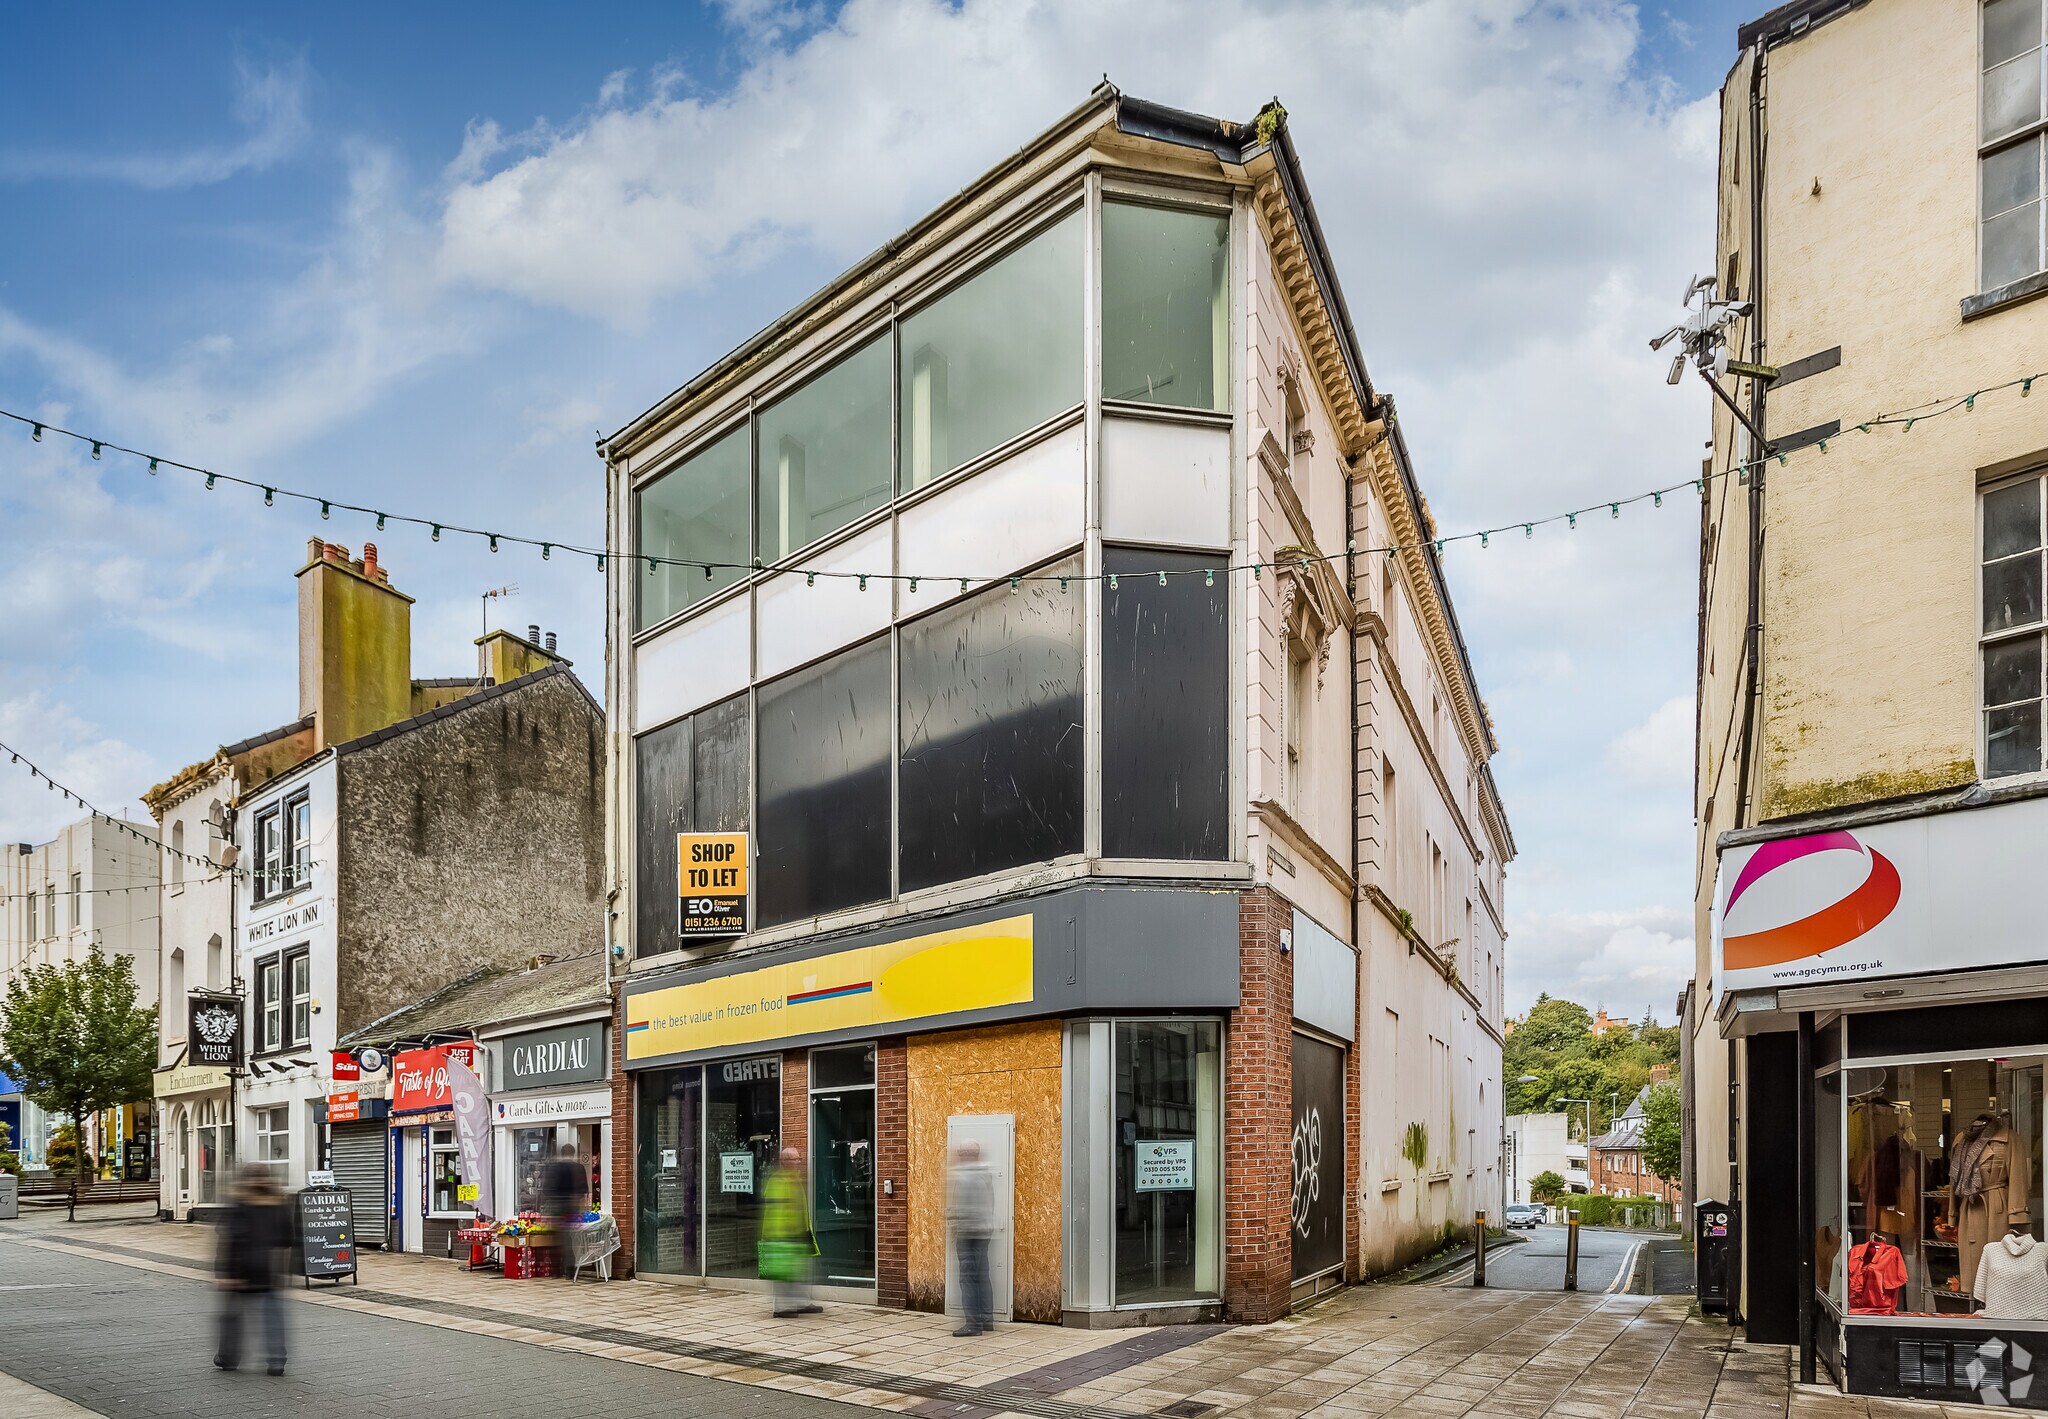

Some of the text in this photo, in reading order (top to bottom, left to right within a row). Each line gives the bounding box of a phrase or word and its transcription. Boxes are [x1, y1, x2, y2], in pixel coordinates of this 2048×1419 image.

[691, 843, 735, 863] SHOP
[688, 868, 738, 888] TO LET
[248, 904, 318, 943] WHITE LION INN
[685, 916, 742, 927] 0151 236 6700
[1772, 959, 1884, 979] www.agecymru.org.uk
[653, 995, 783, 1031] the best value in frozen food
[199, 1044, 233, 1054] WHITE
[204, 1052, 228, 1061] LION
[450, 1048, 470, 1057] JUST
[512, 1037, 591, 1077] CARDIAU
[169, 1072, 214, 1091] Enchantment
[399, 1068, 423, 1099] Taste
[424, 1066, 434, 1097] of
[509, 1101, 533, 1118] Cards
[535, 1099, 555, 1115] Gifts
[556, 1099, 563, 1113] &
[303, 1194, 349, 1206] CARDIAU
[304, 1206, 325, 1214] Cards
[308, 1220, 348, 1229] OCCASIONS
[306, 1235, 327, 1243] Welsh
